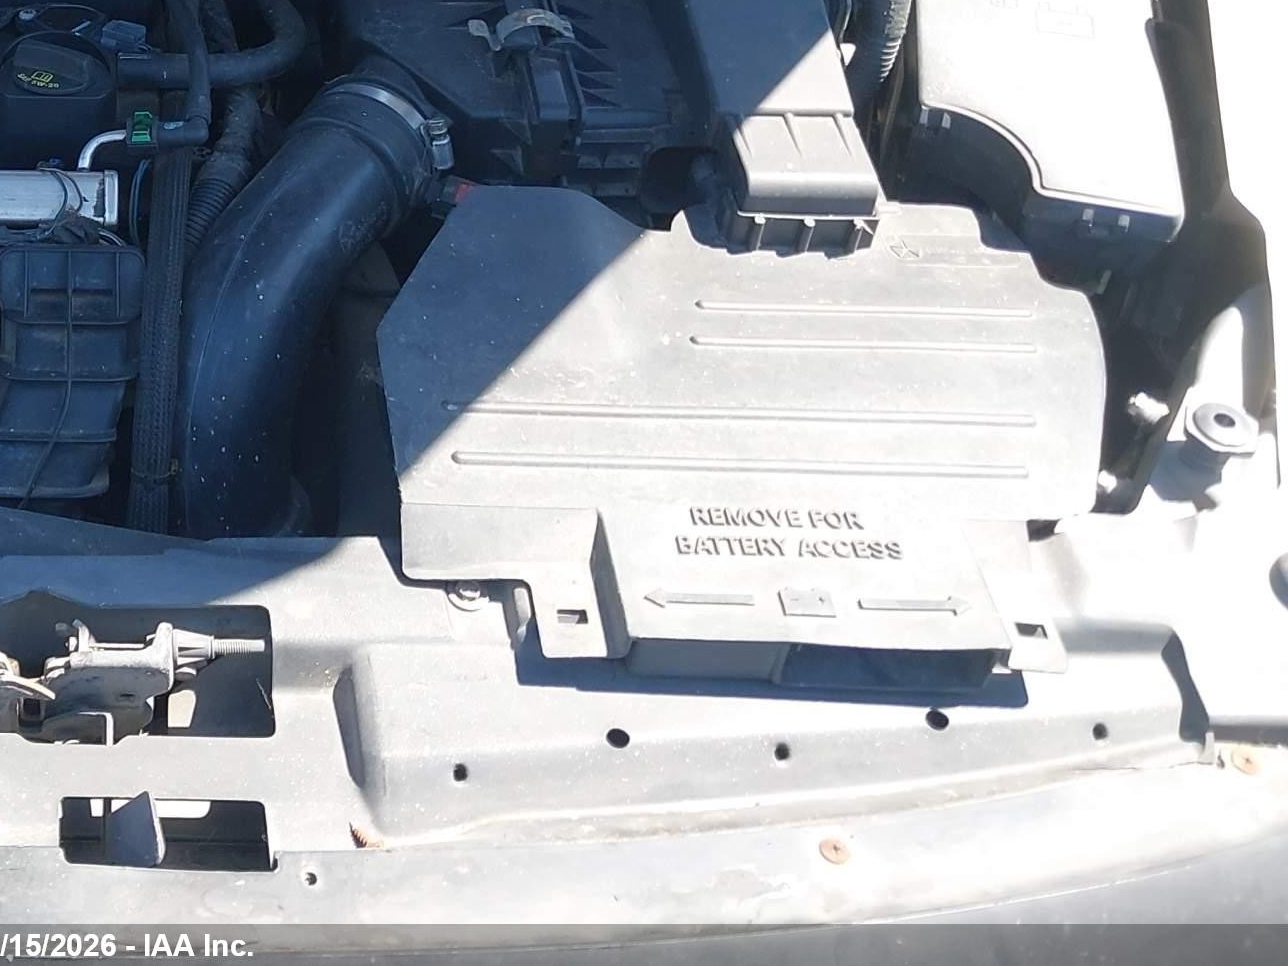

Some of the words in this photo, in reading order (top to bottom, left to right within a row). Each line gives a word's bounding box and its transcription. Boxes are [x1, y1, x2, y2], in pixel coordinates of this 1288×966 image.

[689, 506, 803, 528] REMOVE
[808, 508, 865, 530] FOR
[674, 535, 787, 557] BATTERY
[798, 537, 904, 560] ACCESS
